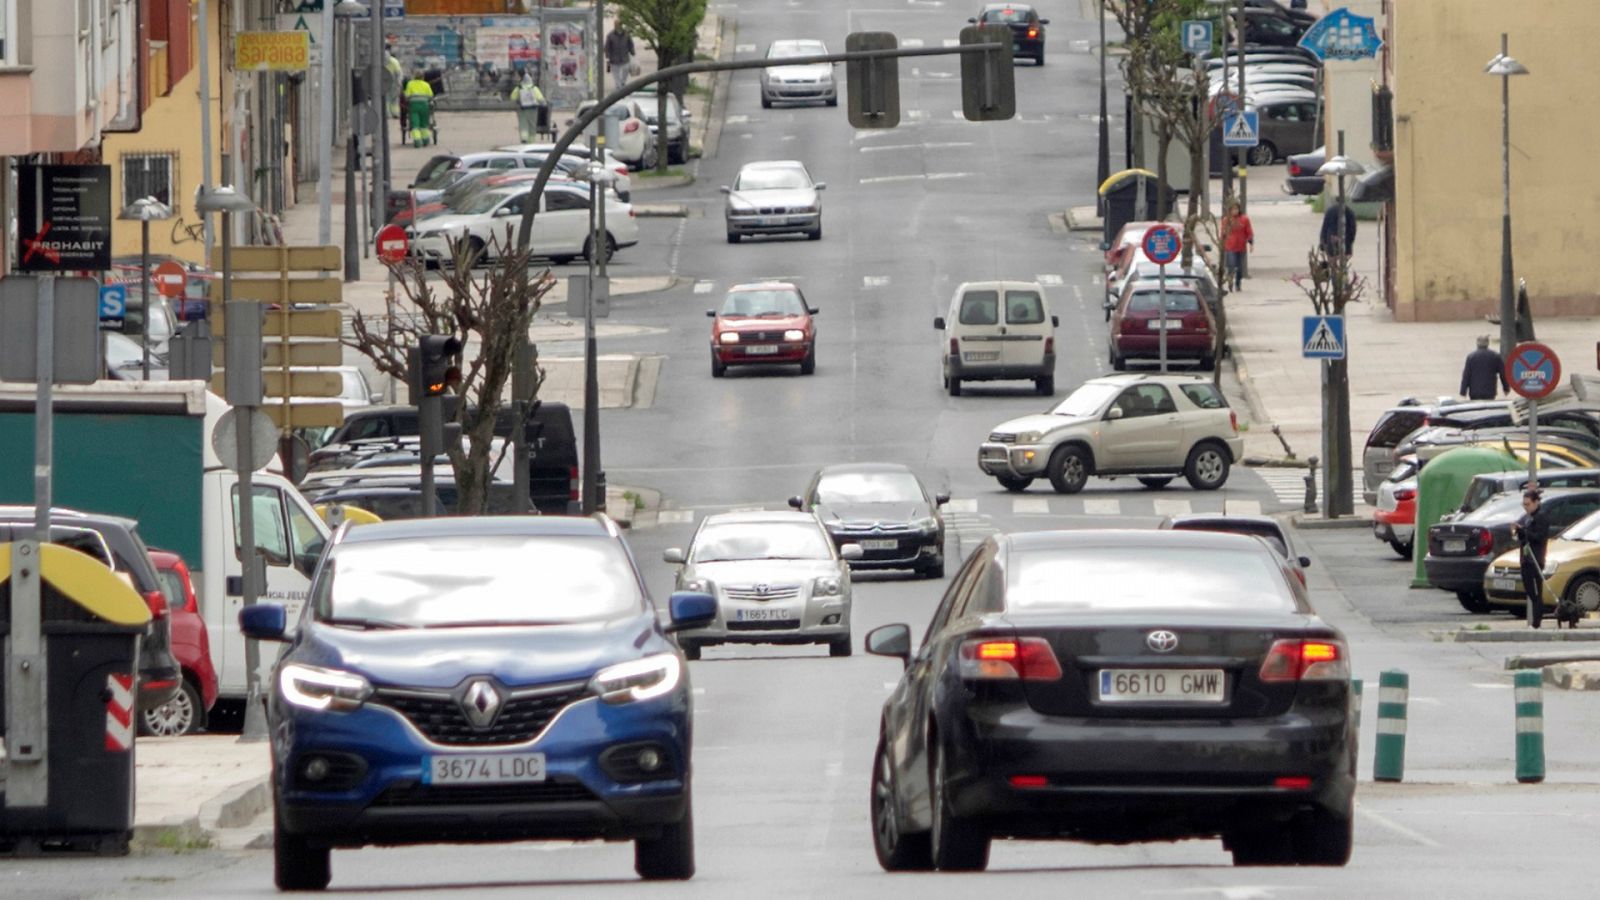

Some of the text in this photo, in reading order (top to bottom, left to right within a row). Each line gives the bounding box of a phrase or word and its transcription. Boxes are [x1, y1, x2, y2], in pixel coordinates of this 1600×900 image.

[1188, 24, 1206, 48] P
[32, 241, 104, 250] PROHABIT
[1520, 370, 1546, 380] EXCEPTO
[1115, 674, 1218, 694] 6610 GMW
[438, 758, 539, 779] 3674 LDC
